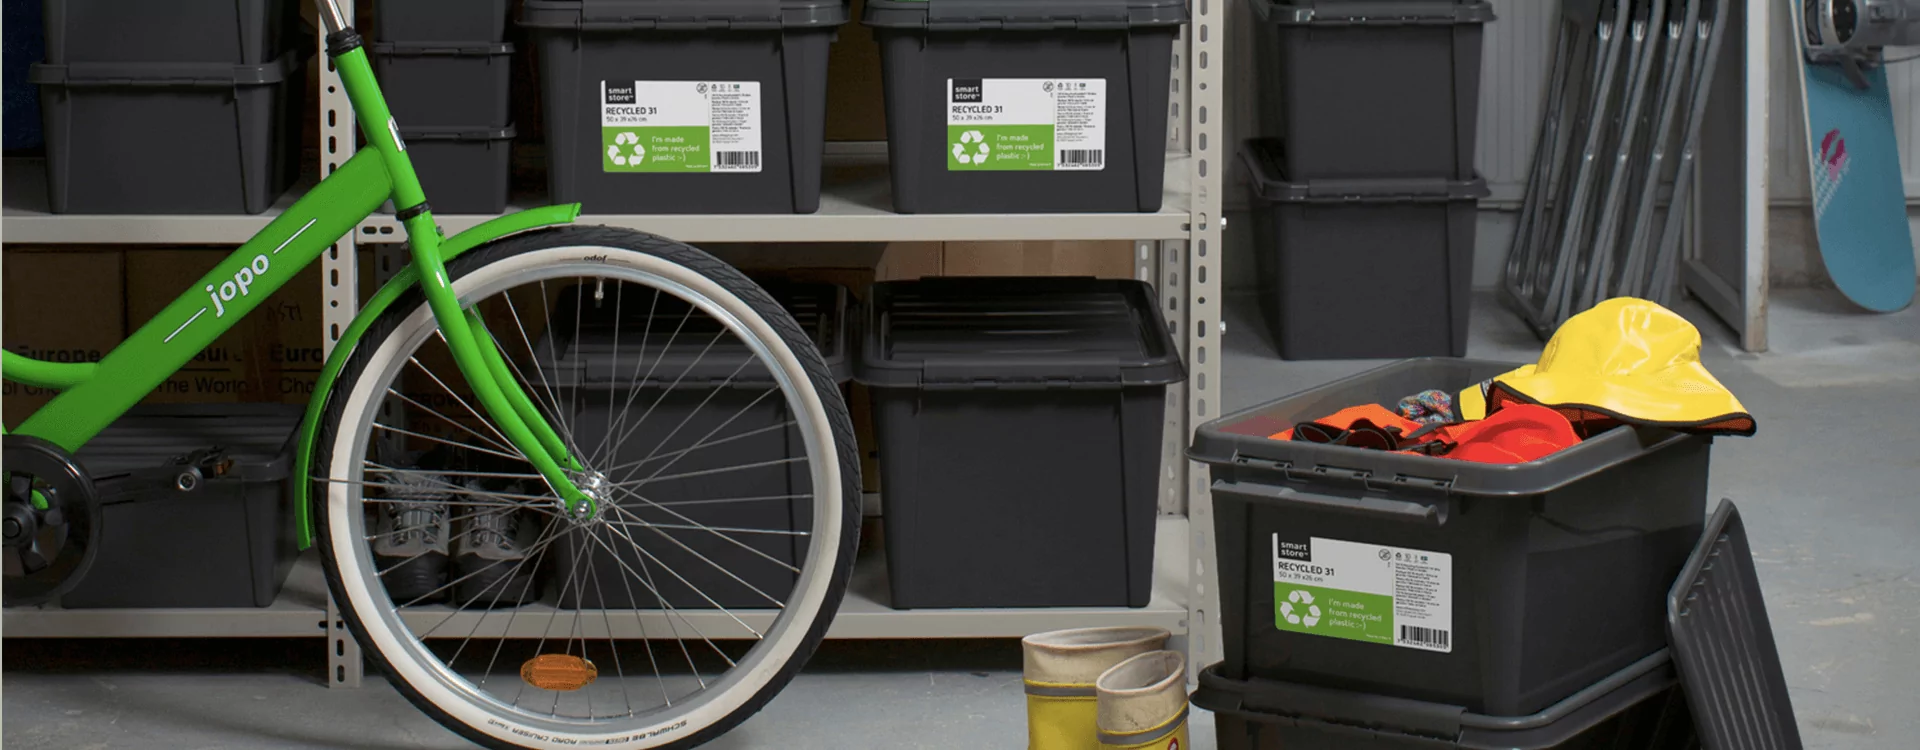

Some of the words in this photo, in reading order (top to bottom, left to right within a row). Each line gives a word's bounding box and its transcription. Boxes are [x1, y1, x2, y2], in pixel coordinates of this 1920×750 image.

[606, 107, 646, 115] RECYCLED
[648, 107, 657, 115] 31
[952, 106, 992, 114] RECYCLED
[994, 106, 1003, 114] 31
[670, 145, 700, 153] recycled
[1014, 144, 1044, 152] recycled
[652, 154, 675, 162] plastic
[996, 152, 1020, 160] plastic
[583, 255, 608, 263] jopo
[206, 254, 269, 318] jopo
[1280, 542, 1307, 550] smart
[1278, 562, 1322, 574] RECYCLED
[1324, 567, 1334, 576] 31
[1328, 598, 1340, 608] I'm
[1342, 600, 1364, 610] made
[1328, 608, 1348, 617] from
[1348, 610, 1382, 622] recycled
[1329, 618, 1354, 628] plastic
[632, 720, 687, 741] SCHWALBE
[512, 728, 549, 742] CRUISER
[552, 737, 578, 745] ROAD
